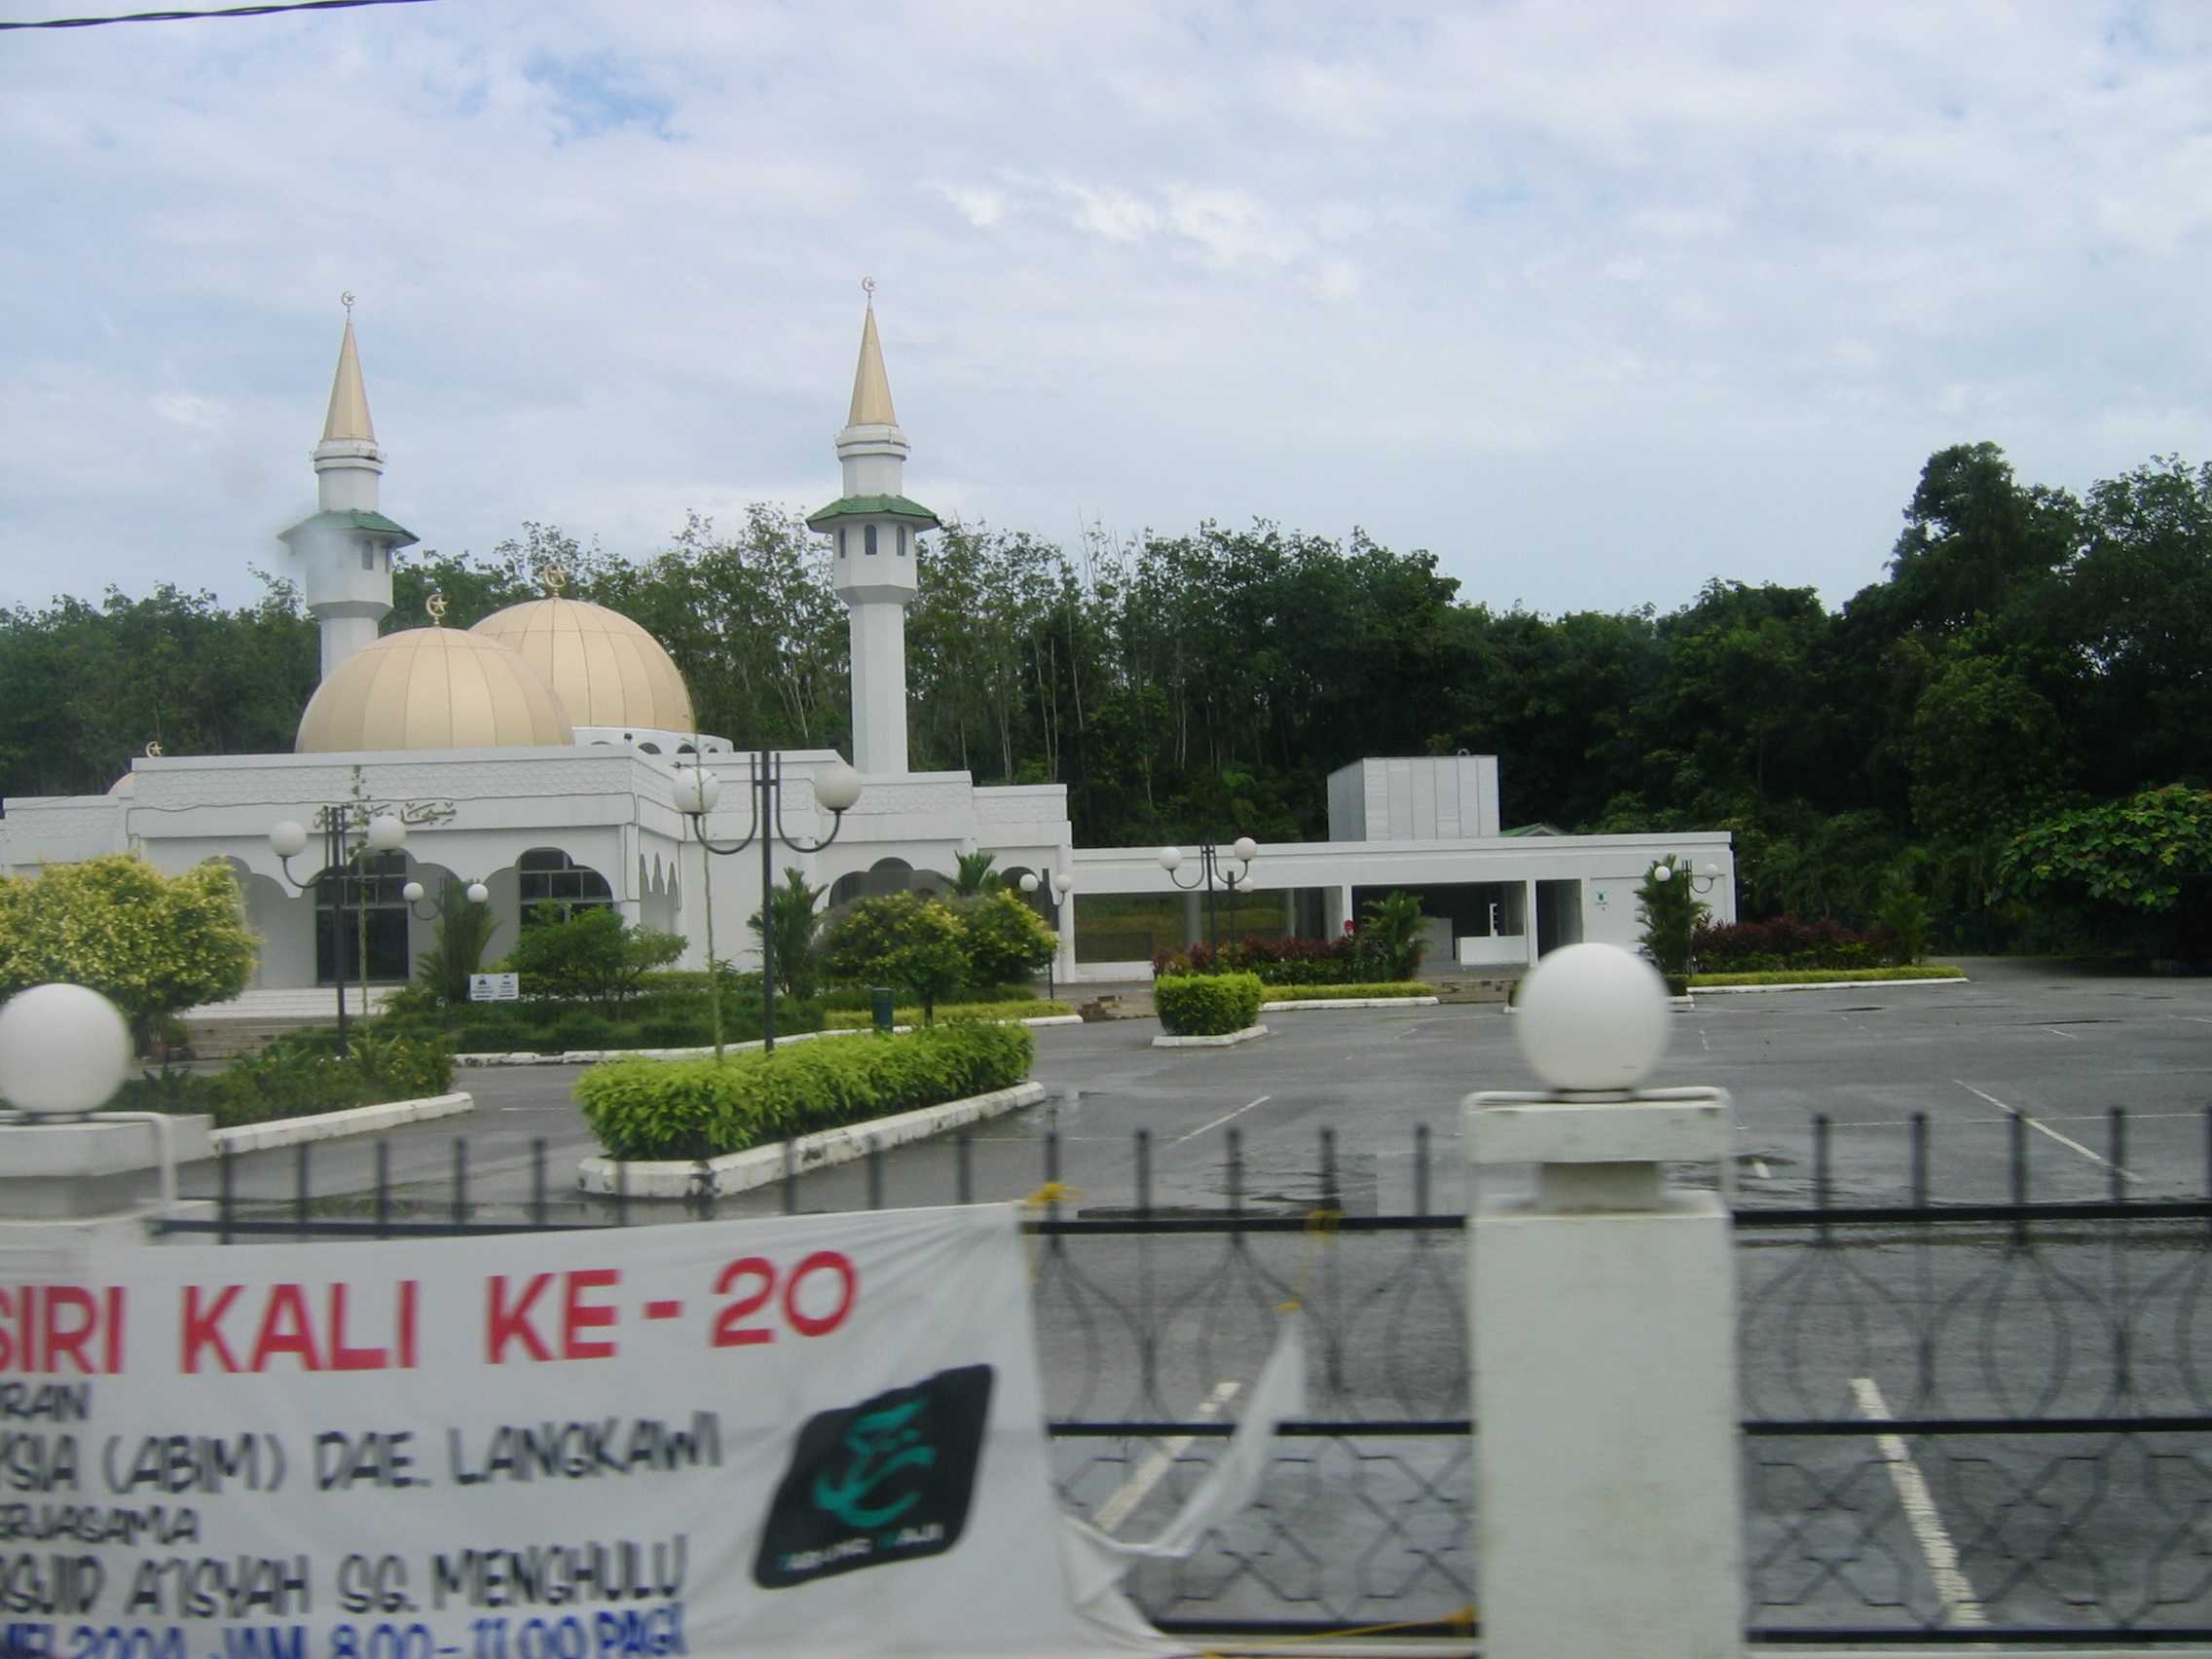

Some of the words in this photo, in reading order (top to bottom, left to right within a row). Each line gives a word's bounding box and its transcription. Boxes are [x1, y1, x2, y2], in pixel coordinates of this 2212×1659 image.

[180, 1279, 420, 1374] KALI
[101, 1431, 285, 1495] (ABIM)
[446, 1410, 722, 1485] LANGKAWI
[428, 1532, 687, 1610] MENGHULU
